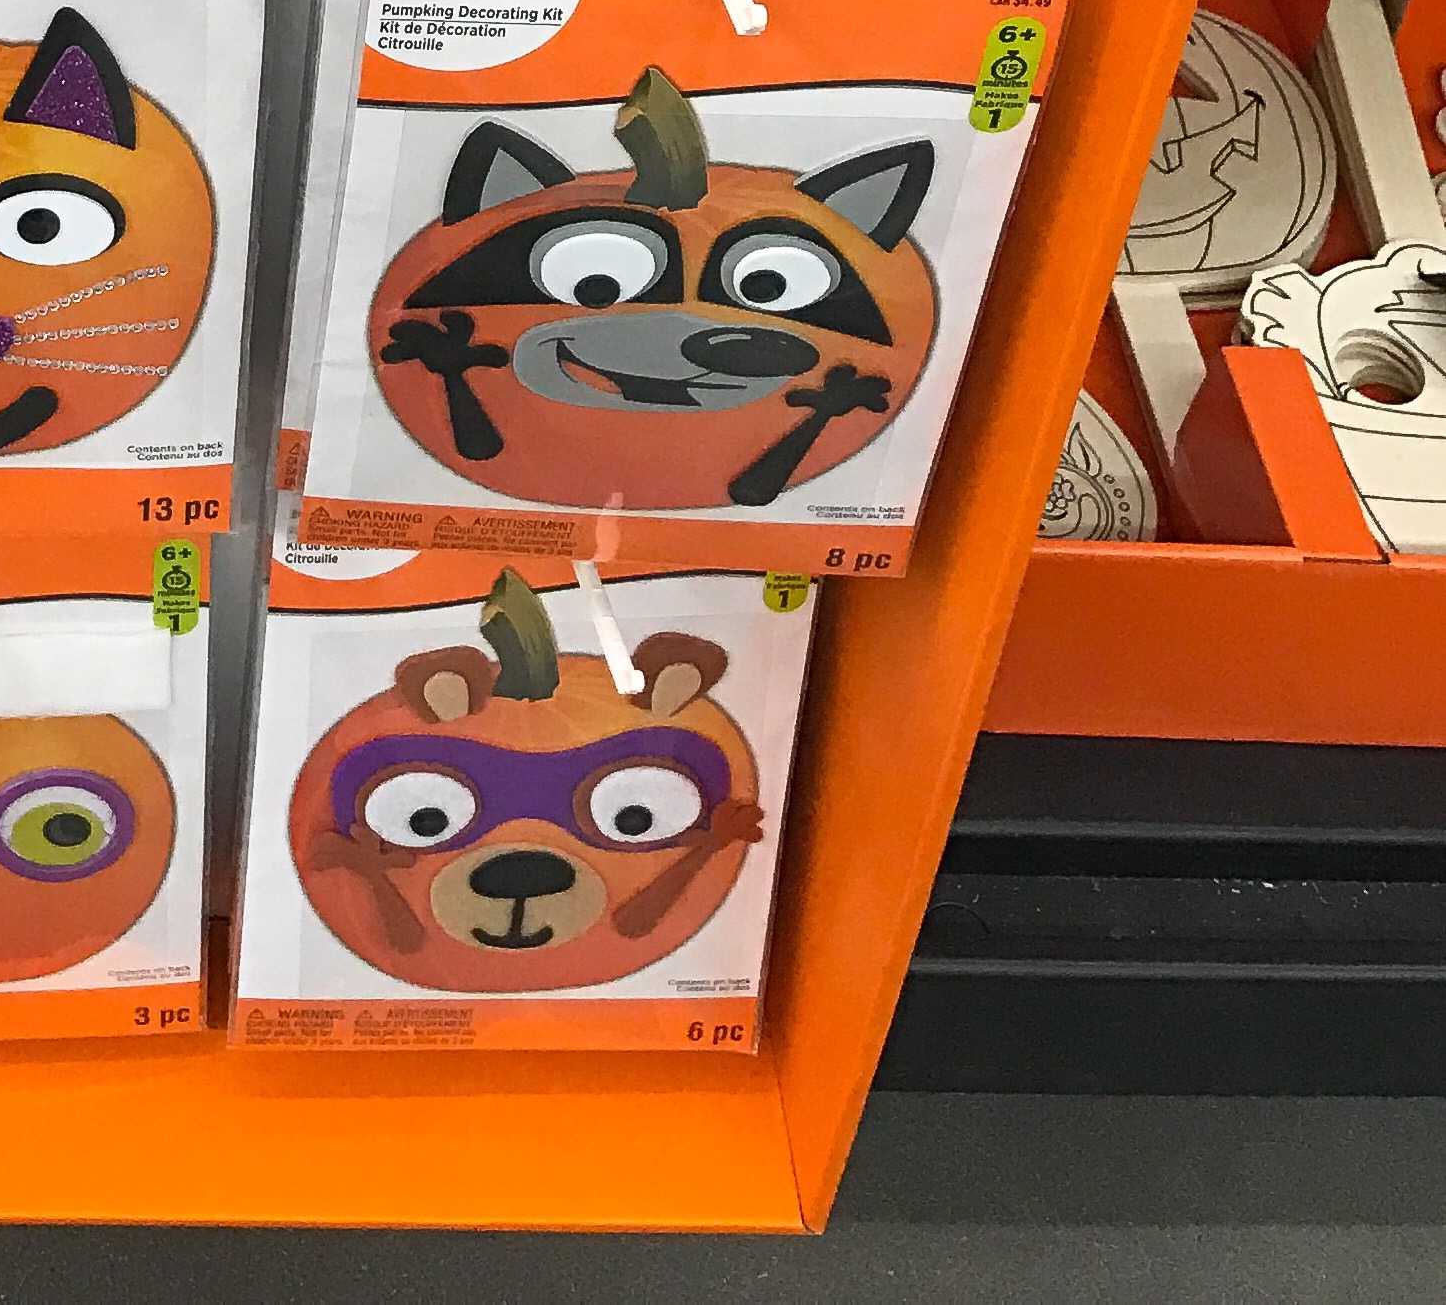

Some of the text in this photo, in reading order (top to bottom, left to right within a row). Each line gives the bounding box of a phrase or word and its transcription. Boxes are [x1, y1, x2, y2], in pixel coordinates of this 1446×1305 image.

[380, 22, 506, 37] Kit de Décoration
[998, 26, 1037, 43] 6+
[378, 37, 443, 51] Citrouille
[988, 109, 1003, 129] 1
[137, 497, 220, 525] 13 pc
[161, 546, 192, 561] 6+
[285, 553, 339, 564] Citrouille
[825, 548, 891, 571] 8 pc
[134, 1006, 191, 1028] 3 pc
[712, 1024, 744, 1047] pc
